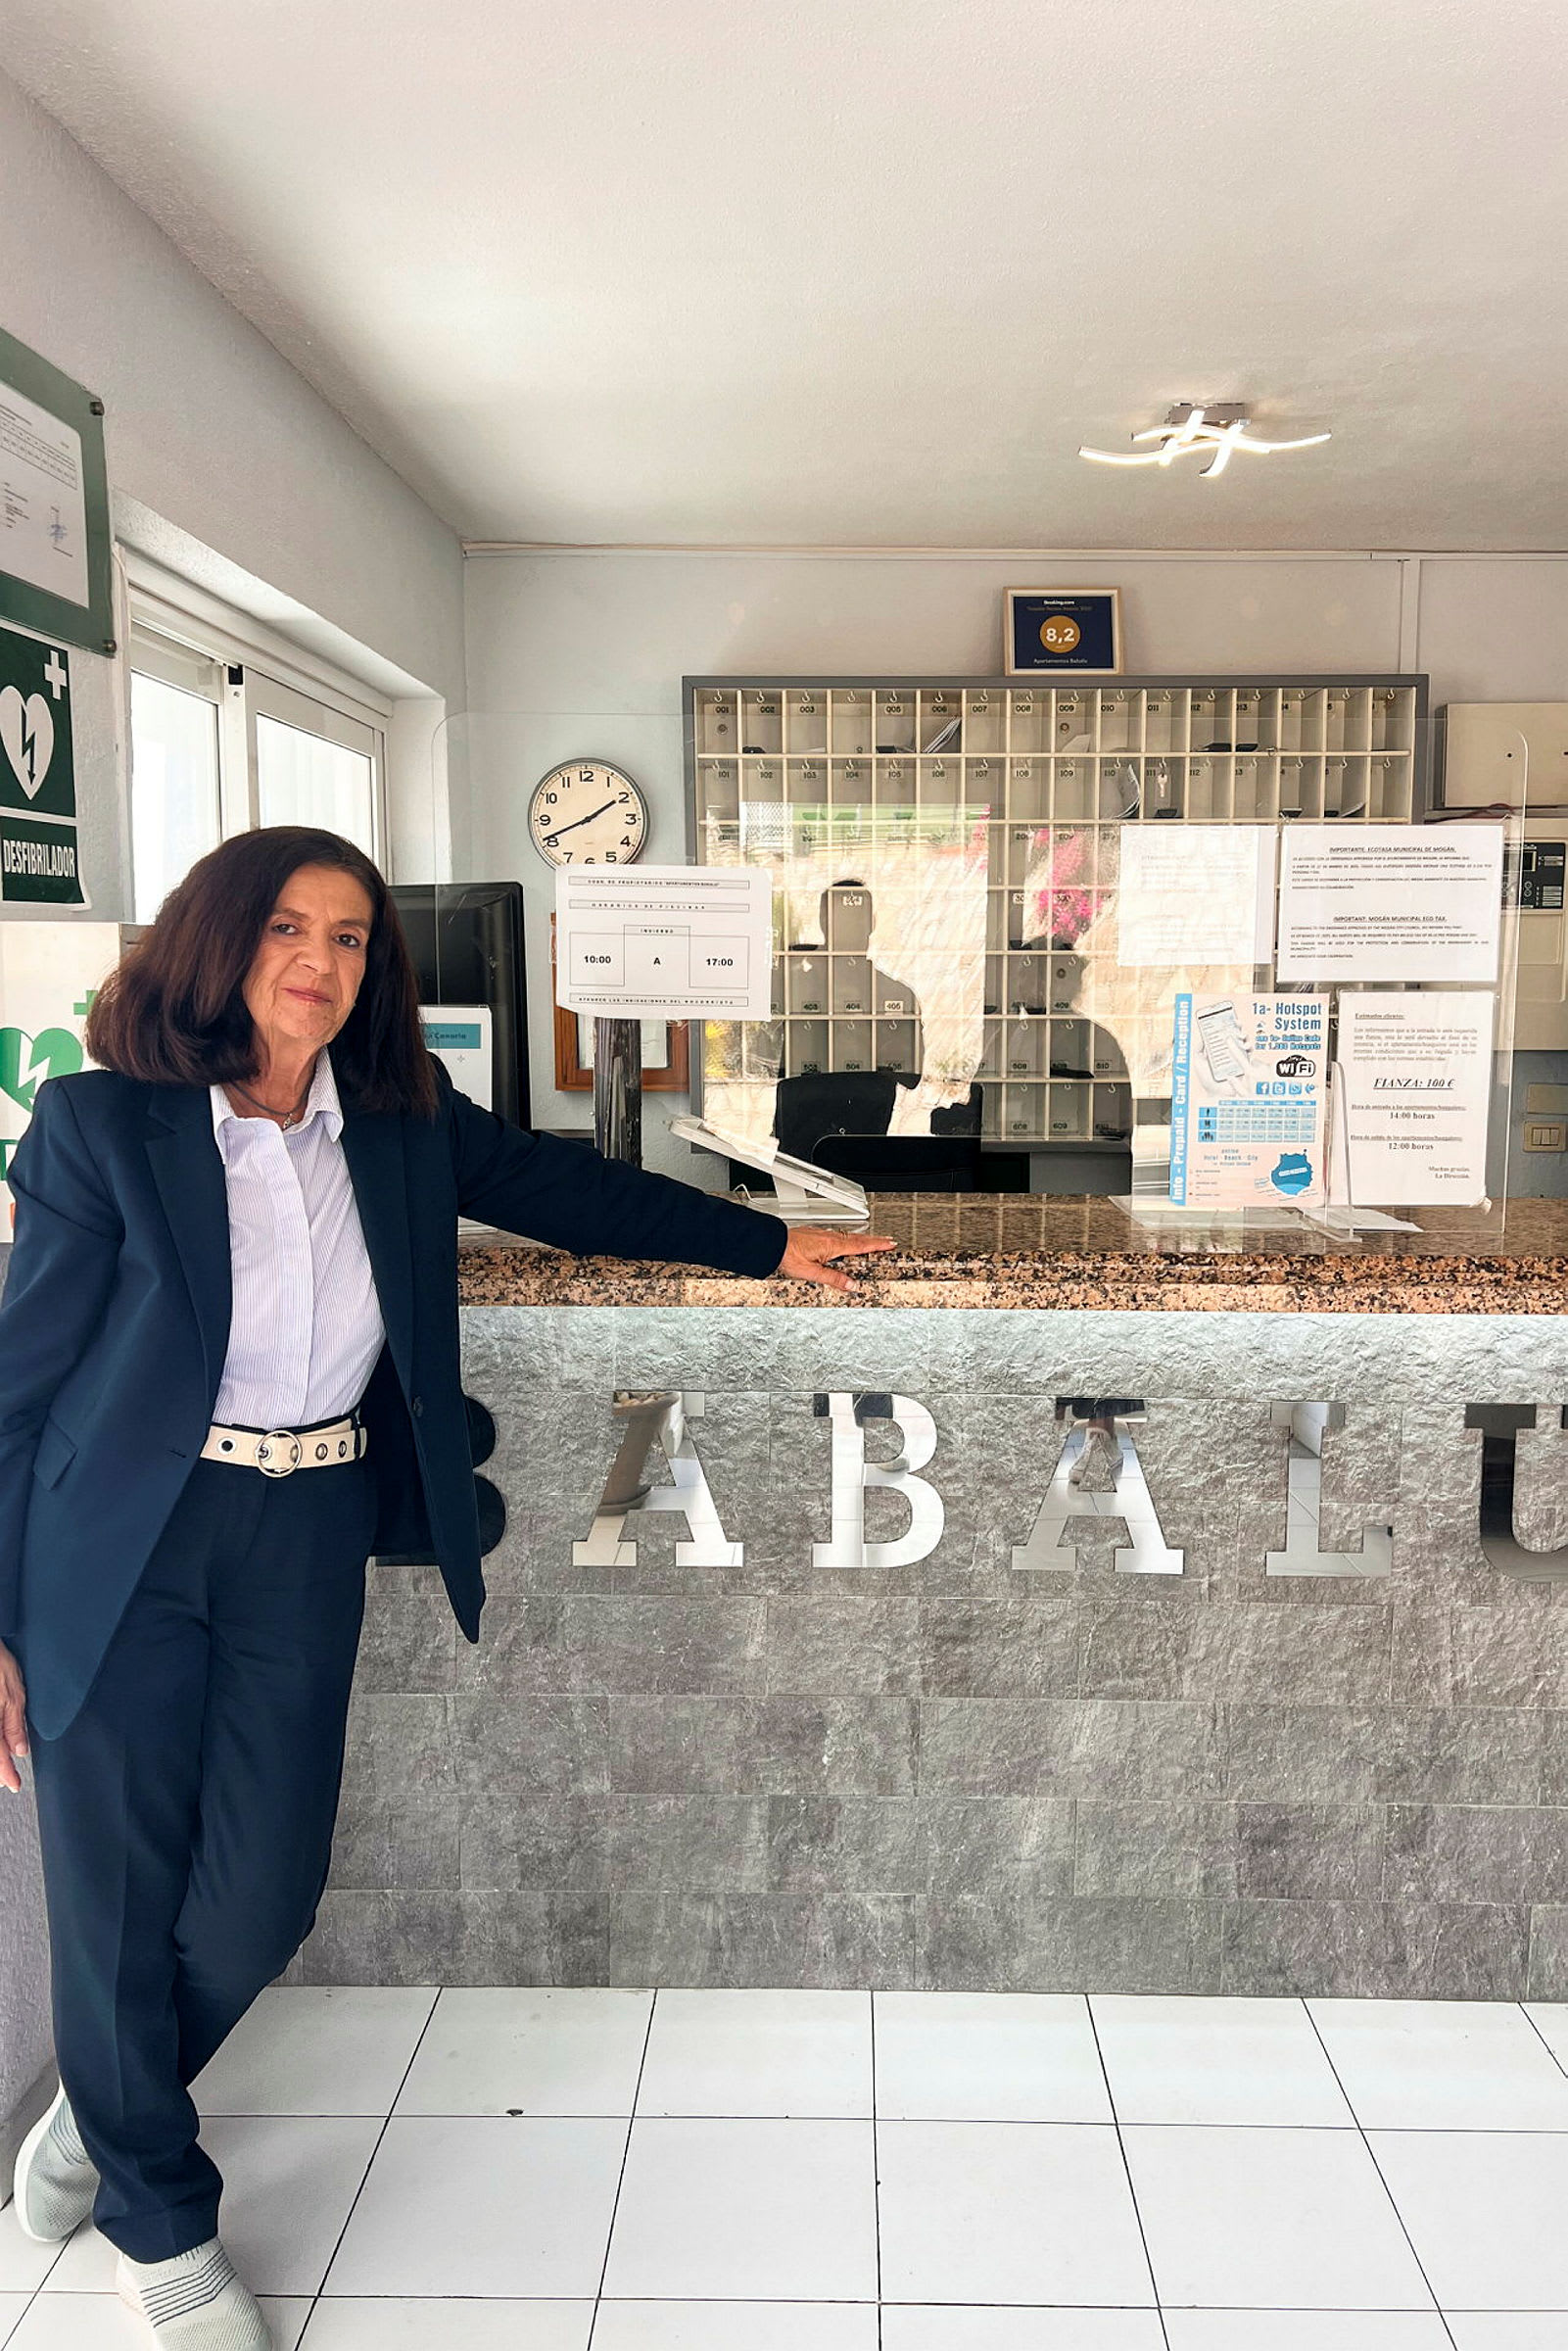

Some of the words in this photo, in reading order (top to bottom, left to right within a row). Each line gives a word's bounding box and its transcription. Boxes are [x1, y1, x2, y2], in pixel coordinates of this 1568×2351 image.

[1046, 627, 1074, 644] 8,2
[580, 770, 594, 782] 12
[562, 777, 570, 788] 11
[607, 777, 610, 788] 1
[546, 792, 557, 803] 10
[618, 792, 630, 803] 2
[540, 815, 550, 826] 9
[626, 814, 637, 825] 3
[546, 836, 559, 847] 8
[620, 836, 632, 846] 4
[3, 839, 75, 878] DESFIBRILADOR
[563, 852, 573, 863] 7
[605, 851, 617, 863] 5
[584, 955, 612, 964] 10:00
[653, 957, 661, 966] A
[706, 958, 734, 967] 17:00
[1275, 1002, 1321, 1016] Hotspot
[1275, 1017, 1321, 1031] System
[1176, 1001, 1189, 1064] Reception
[1373, 1078, 1423, 1088] FIANZA:
[1427, 1078, 1446, 1088] 100
[1175, 1076, 1187, 1105] Card
[1173, 1117, 1185, 1165] Prepaid
[1171, 1176, 1184, 1200] Info
